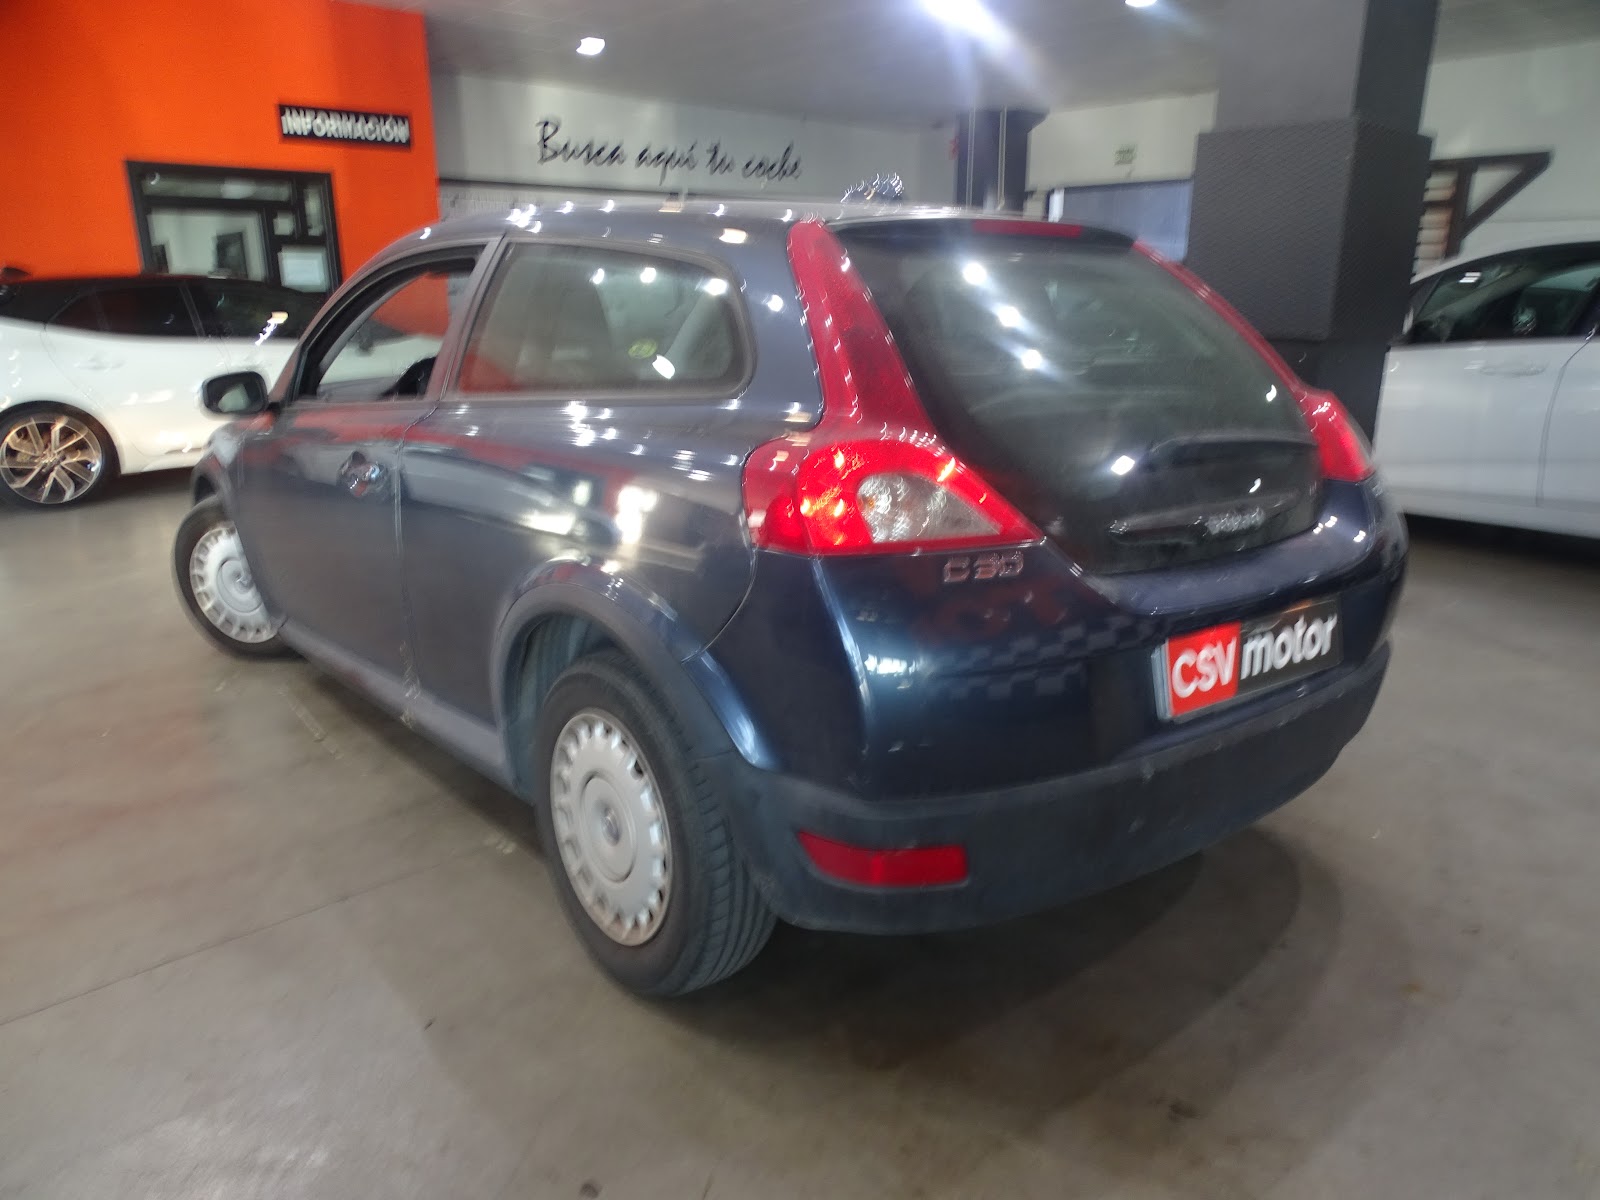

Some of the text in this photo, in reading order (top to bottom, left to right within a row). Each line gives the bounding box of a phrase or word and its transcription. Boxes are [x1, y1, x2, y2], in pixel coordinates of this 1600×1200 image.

[282, 108, 410, 143] INFORMACIÓN
[536, 117, 803, 182] Busca aquí tu coche
[1241, 613, 1338, 680] motor
